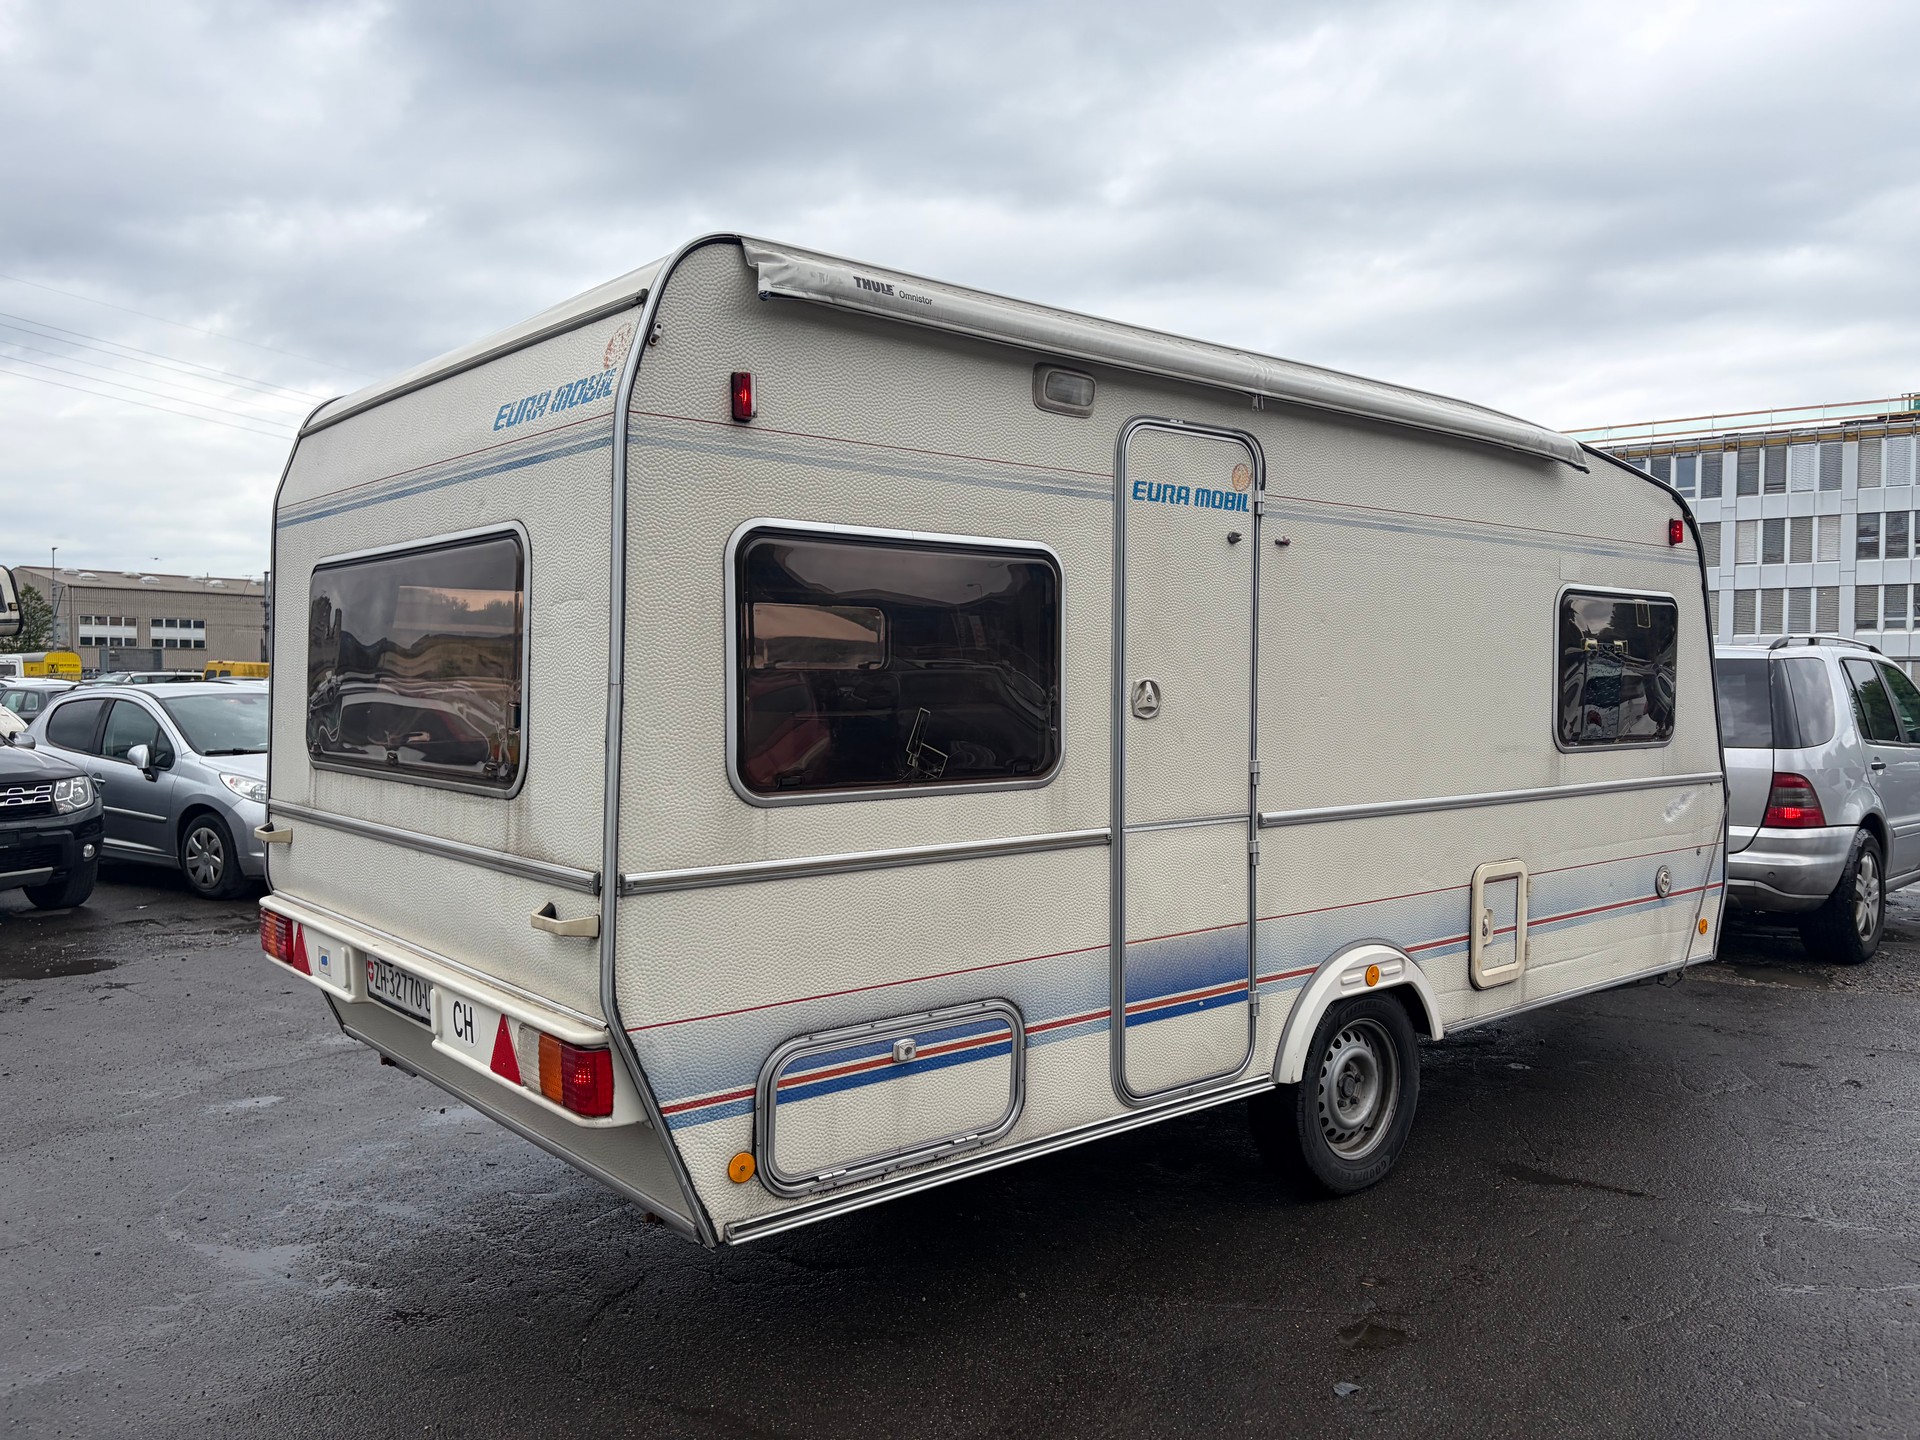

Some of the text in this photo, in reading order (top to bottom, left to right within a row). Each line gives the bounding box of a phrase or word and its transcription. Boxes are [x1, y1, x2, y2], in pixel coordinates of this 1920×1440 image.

[853, 276, 933, 305] THULE Omnistor
[493, 368, 617, 431] EURA MOBIL
[1132, 480, 1250, 512] EURA MOBIL
[453, 1001, 474, 1043] CH
